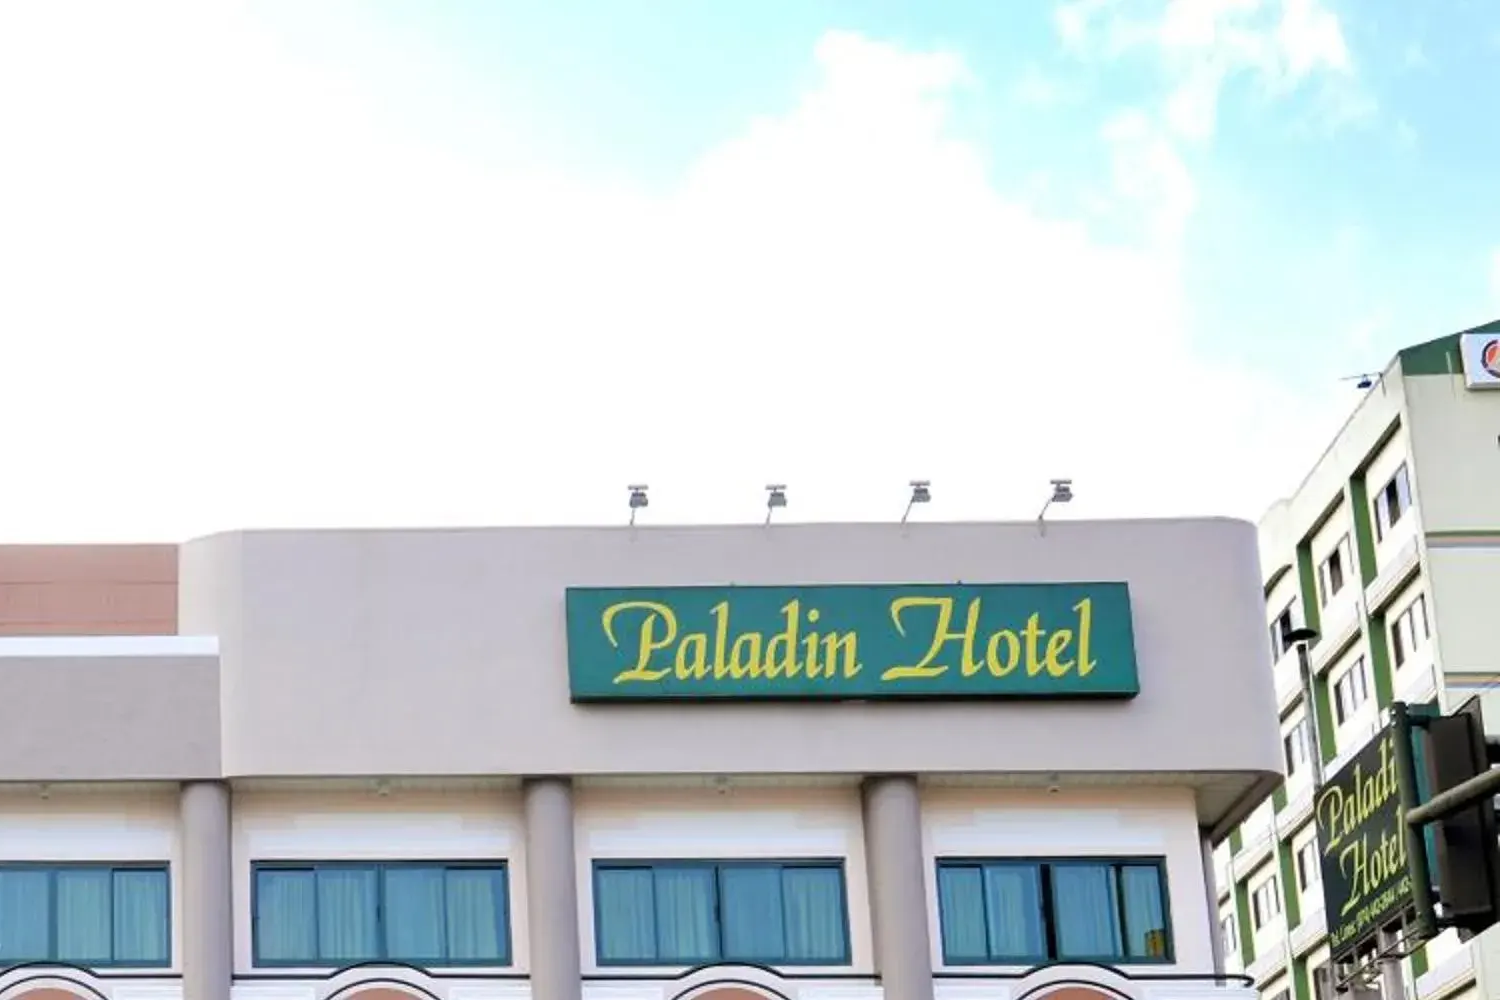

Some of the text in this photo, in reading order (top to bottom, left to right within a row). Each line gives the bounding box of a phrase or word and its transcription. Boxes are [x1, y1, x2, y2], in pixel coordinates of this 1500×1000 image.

[602, 597, 1097, 684] Paladin Hotel
[1317, 737, 1398, 857] Paladi
[1339, 804, 1406, 917] Hotel
